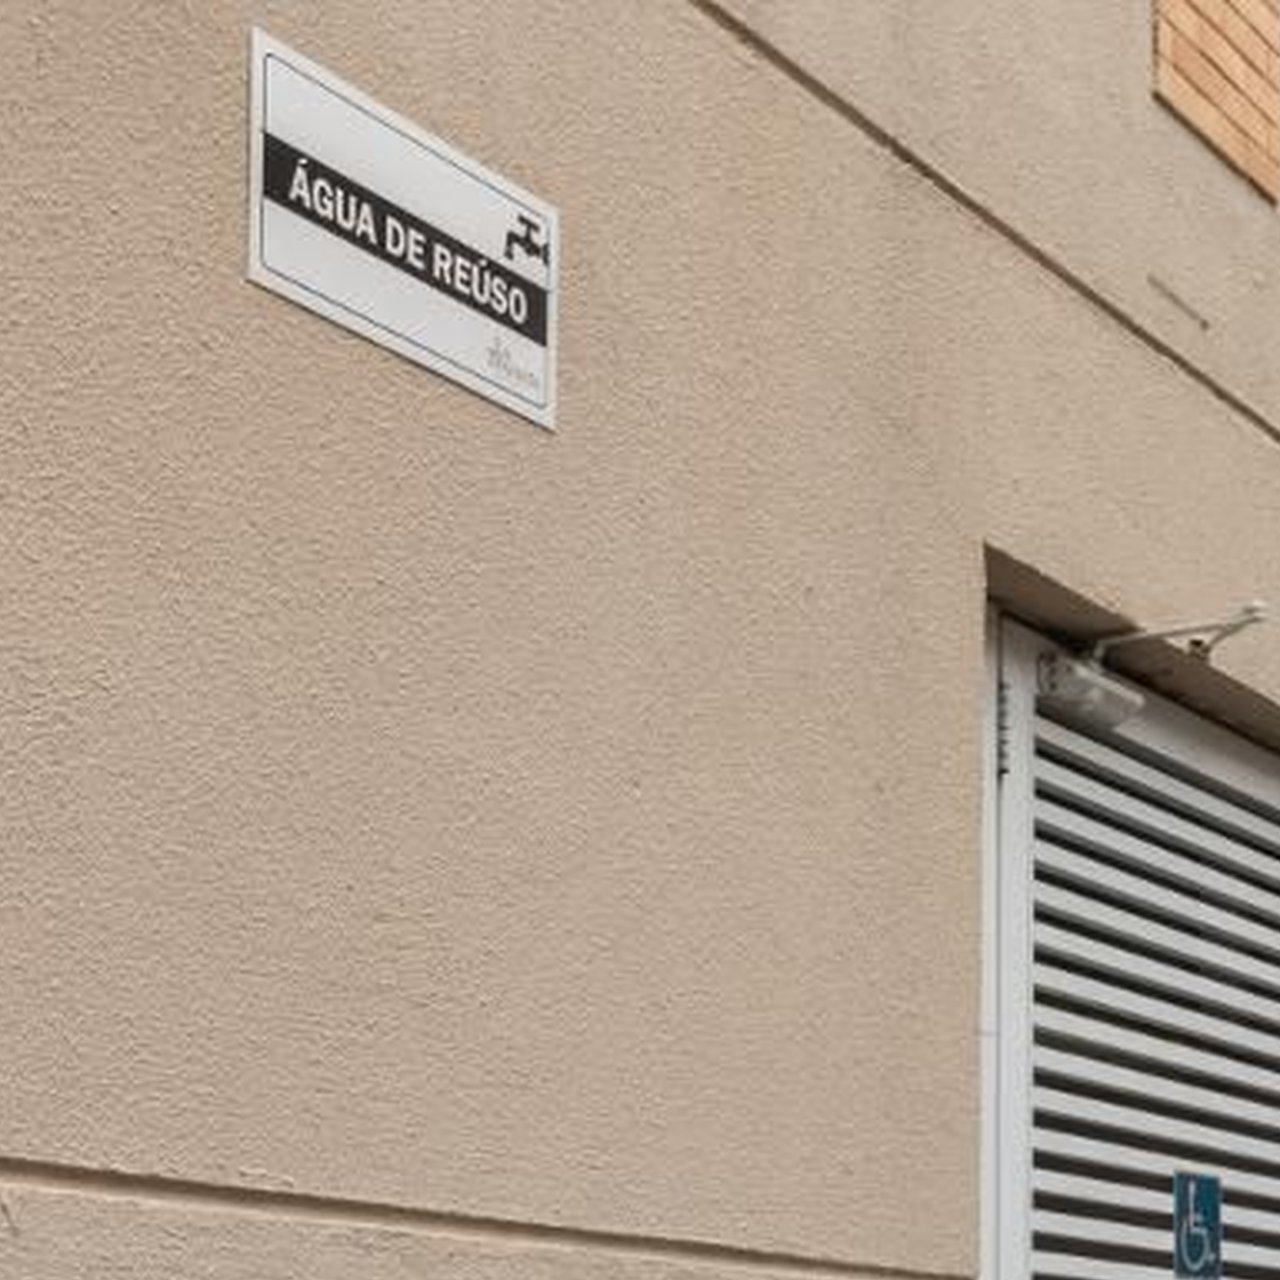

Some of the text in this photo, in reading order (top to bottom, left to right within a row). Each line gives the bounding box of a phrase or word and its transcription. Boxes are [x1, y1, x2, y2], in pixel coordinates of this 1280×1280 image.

[288, 157, 528, 325] ÁGUA DE REÚSO
